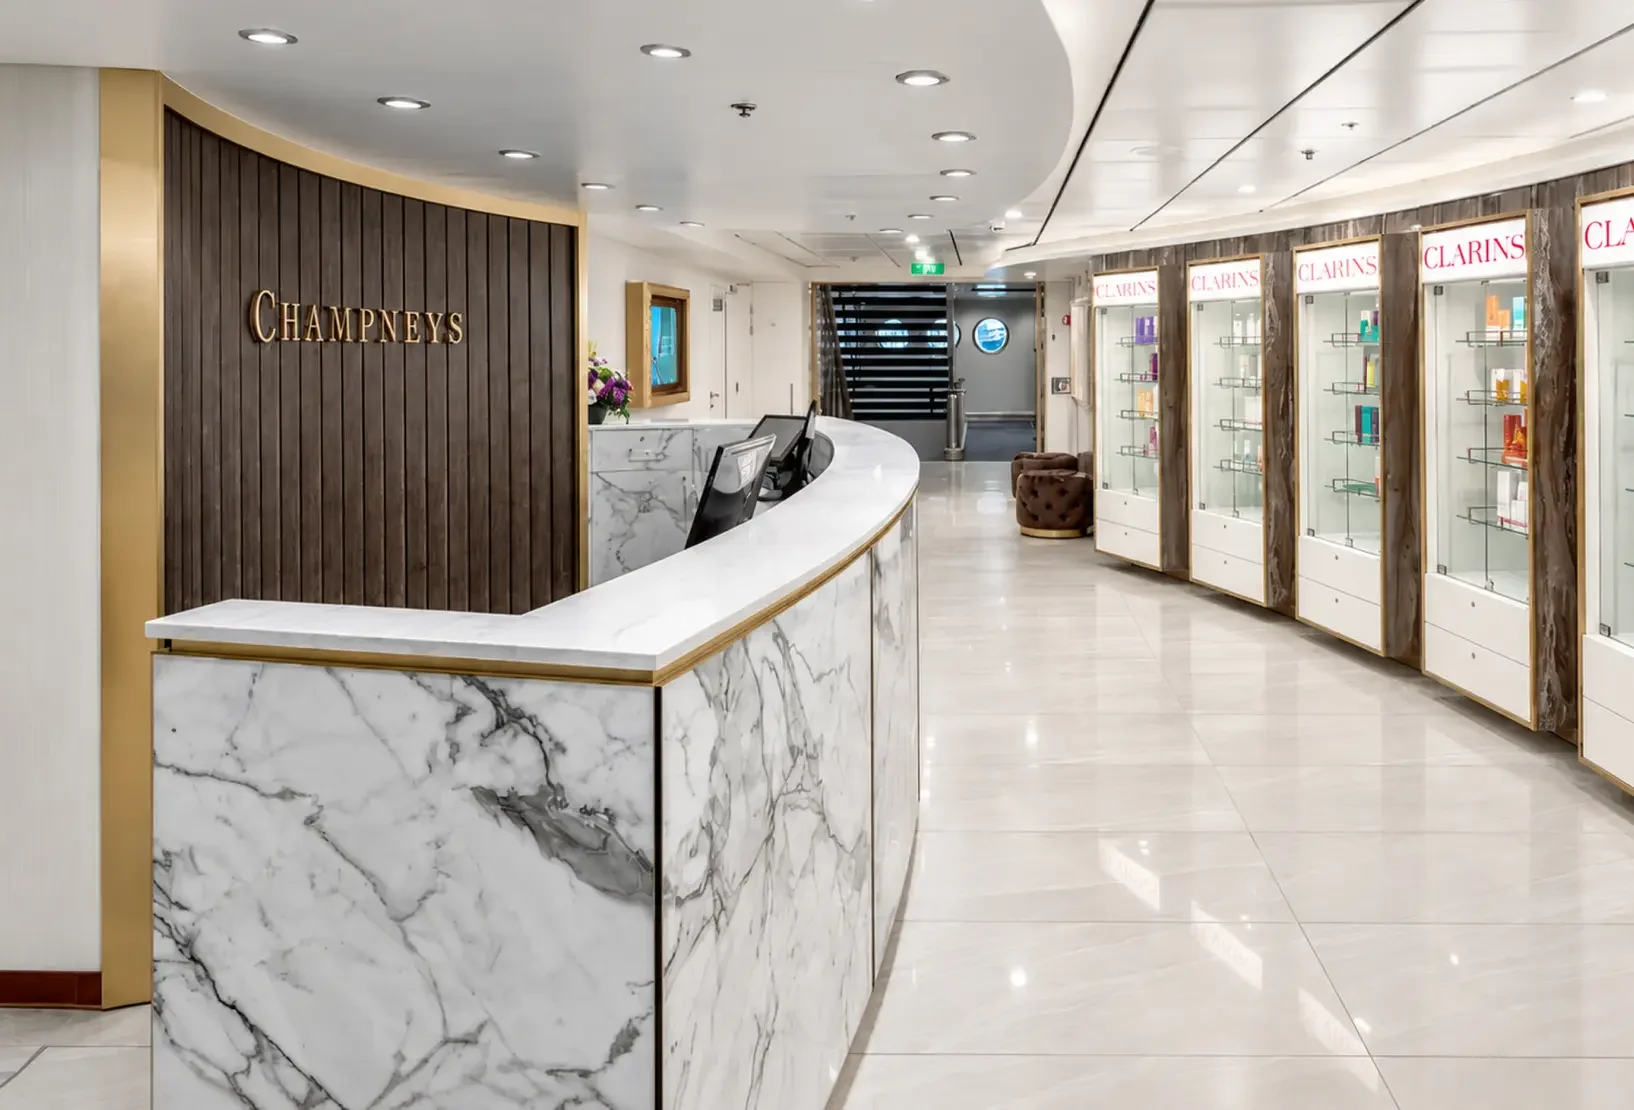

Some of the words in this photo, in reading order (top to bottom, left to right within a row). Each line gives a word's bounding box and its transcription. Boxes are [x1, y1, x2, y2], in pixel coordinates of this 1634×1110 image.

[1423, 234, 1525, 270] CLARINS
[1191, 270, 1259, 292] CLARINS
[1298, 255, 1377, 281] CLARINS
[1095, 280, 1156, 298] CLARINS
[250, 289, 464, 344] CHAMPNEYS
